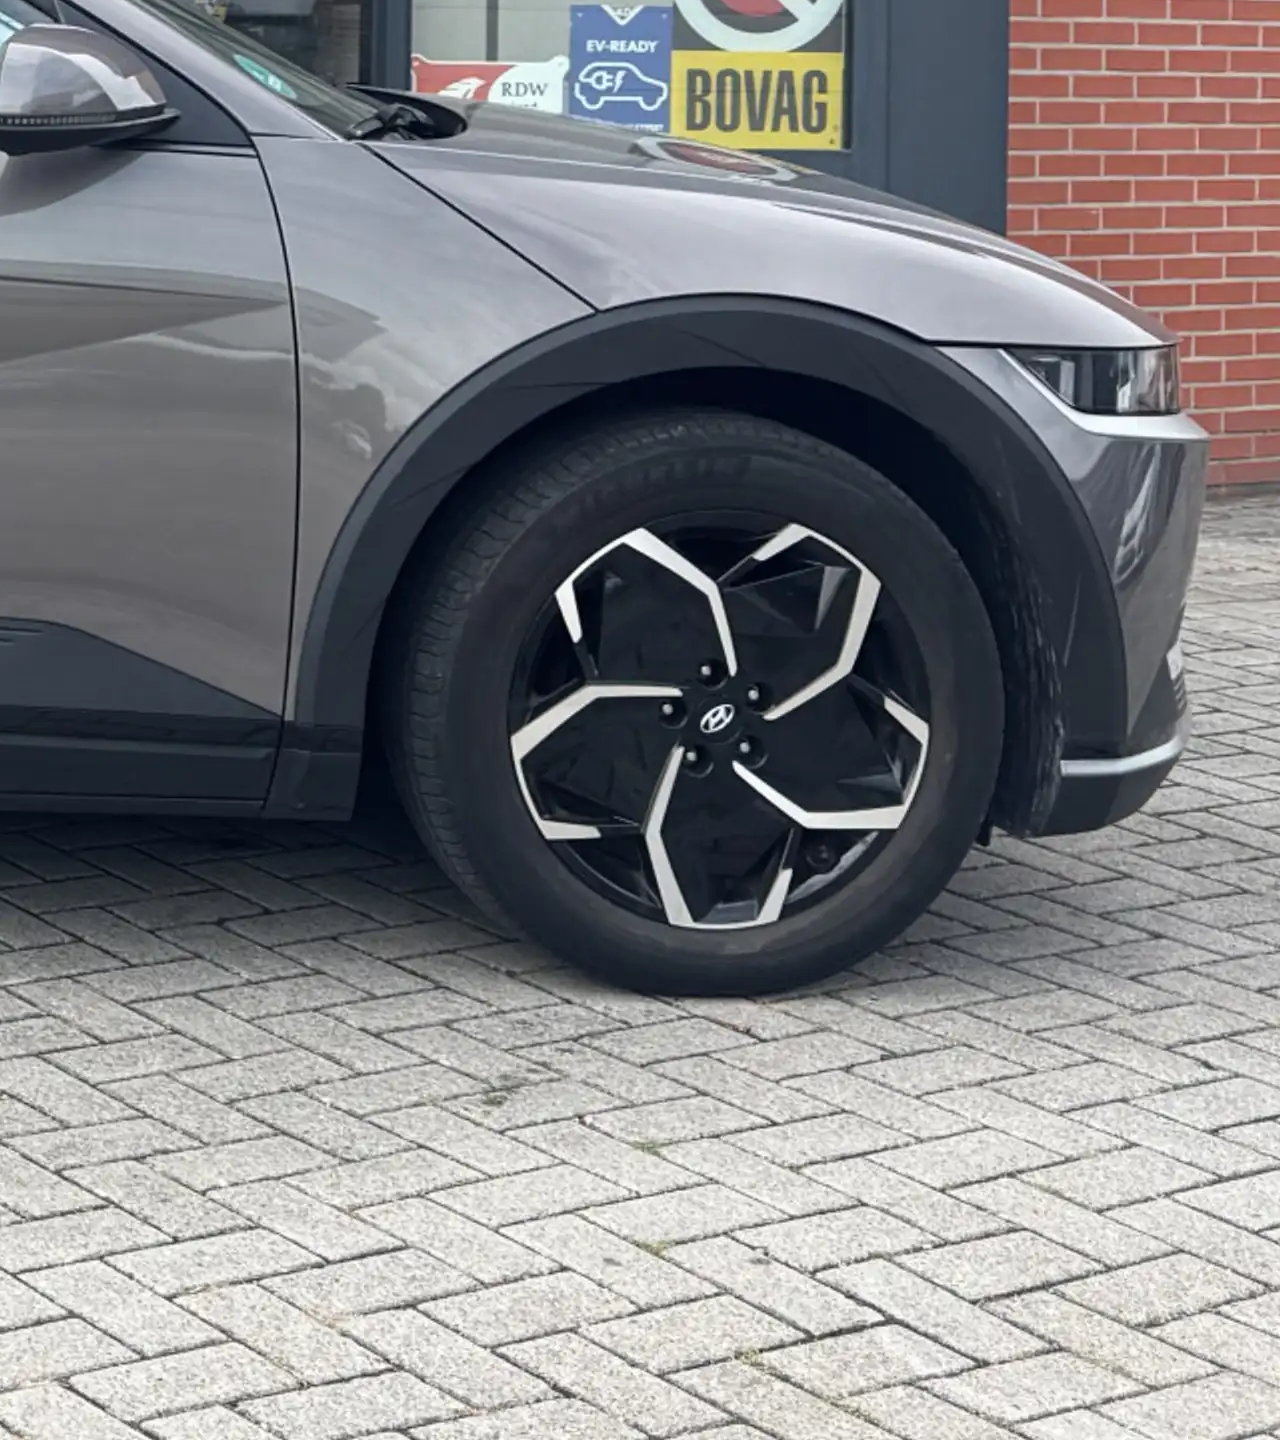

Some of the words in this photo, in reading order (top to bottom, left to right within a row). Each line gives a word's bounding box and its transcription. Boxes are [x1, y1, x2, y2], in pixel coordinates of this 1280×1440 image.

[586, 39, 659, 53] EV-READY
[500, 81, 550, 97] RDW
[686, 68, 828, 134] BOVAG
